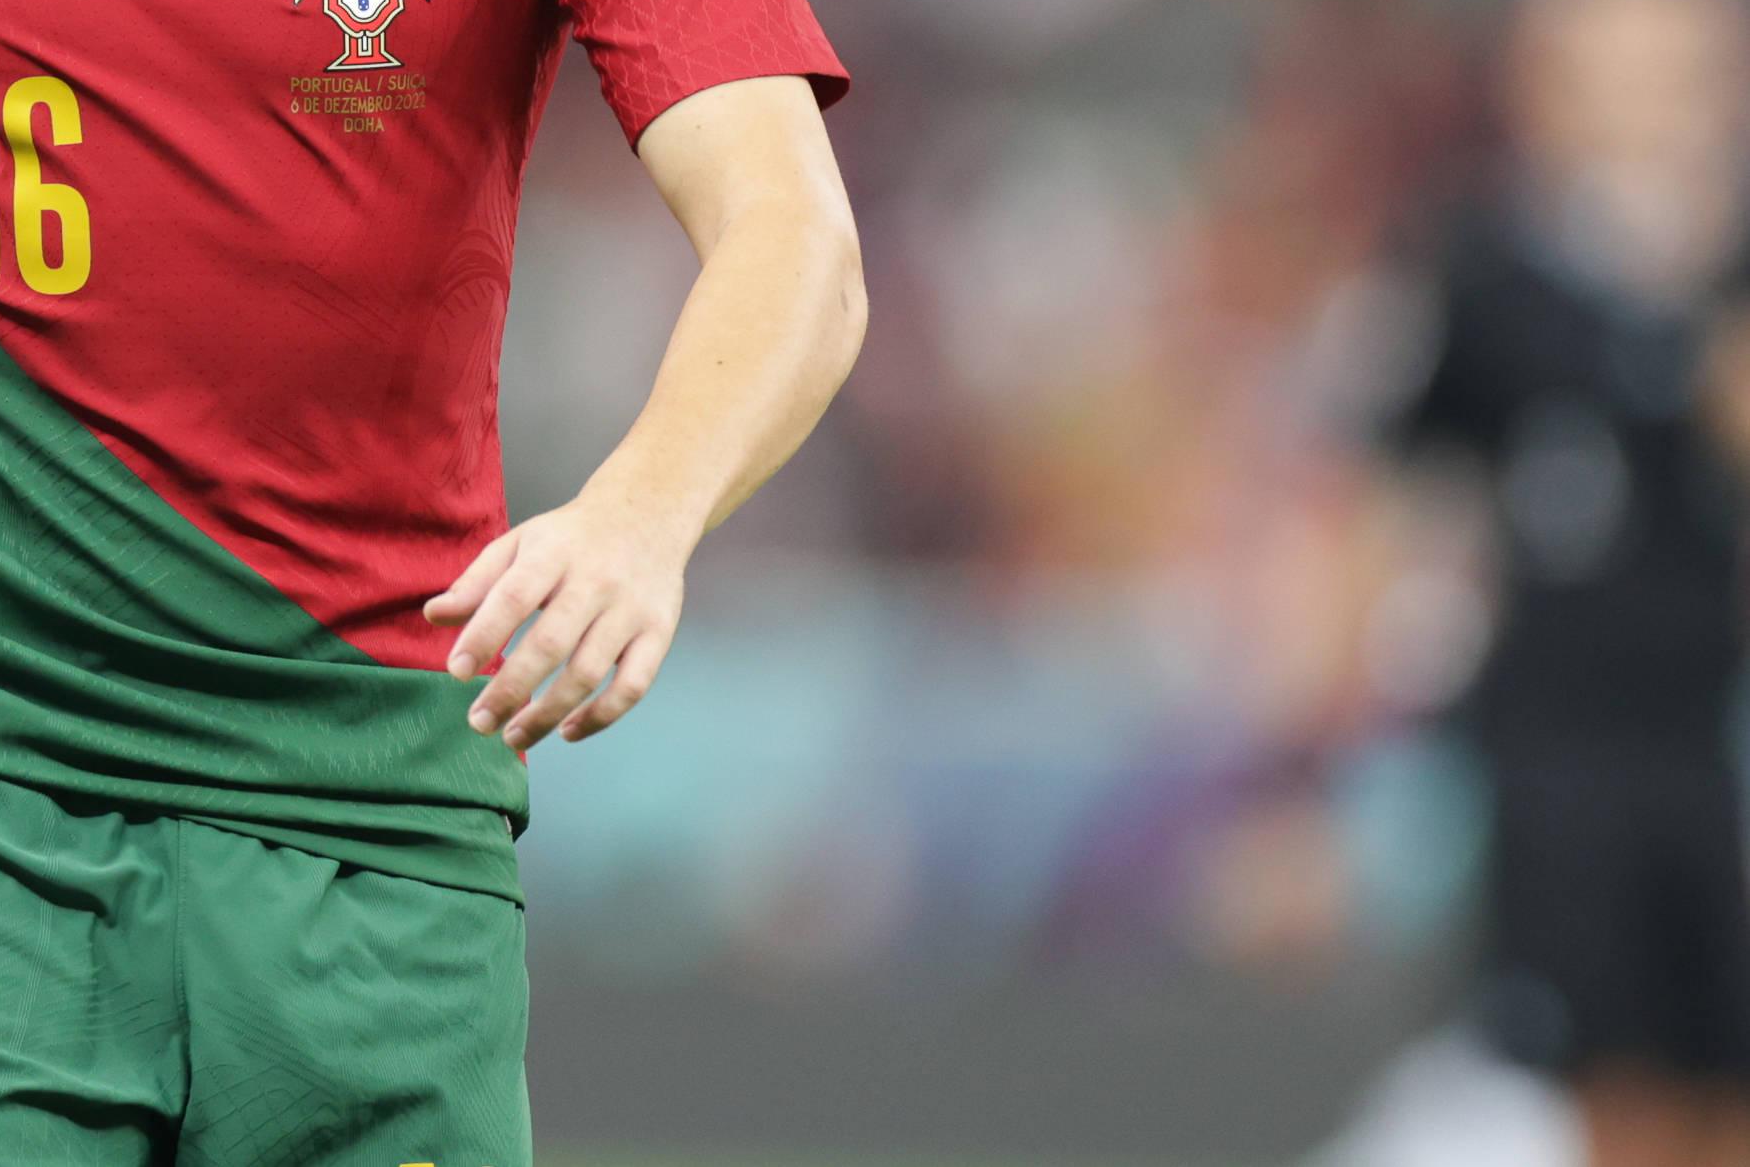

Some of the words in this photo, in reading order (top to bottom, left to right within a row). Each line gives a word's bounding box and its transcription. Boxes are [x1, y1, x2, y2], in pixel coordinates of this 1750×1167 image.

[291, 77, 372, 93] PORTUGAL
[291, 97, 299, 114] 6
[304, 97, 320, 114] DE
[324, 95, 392, 114] DEZEMBRO
[344, 117, 385, 132] DOHA
